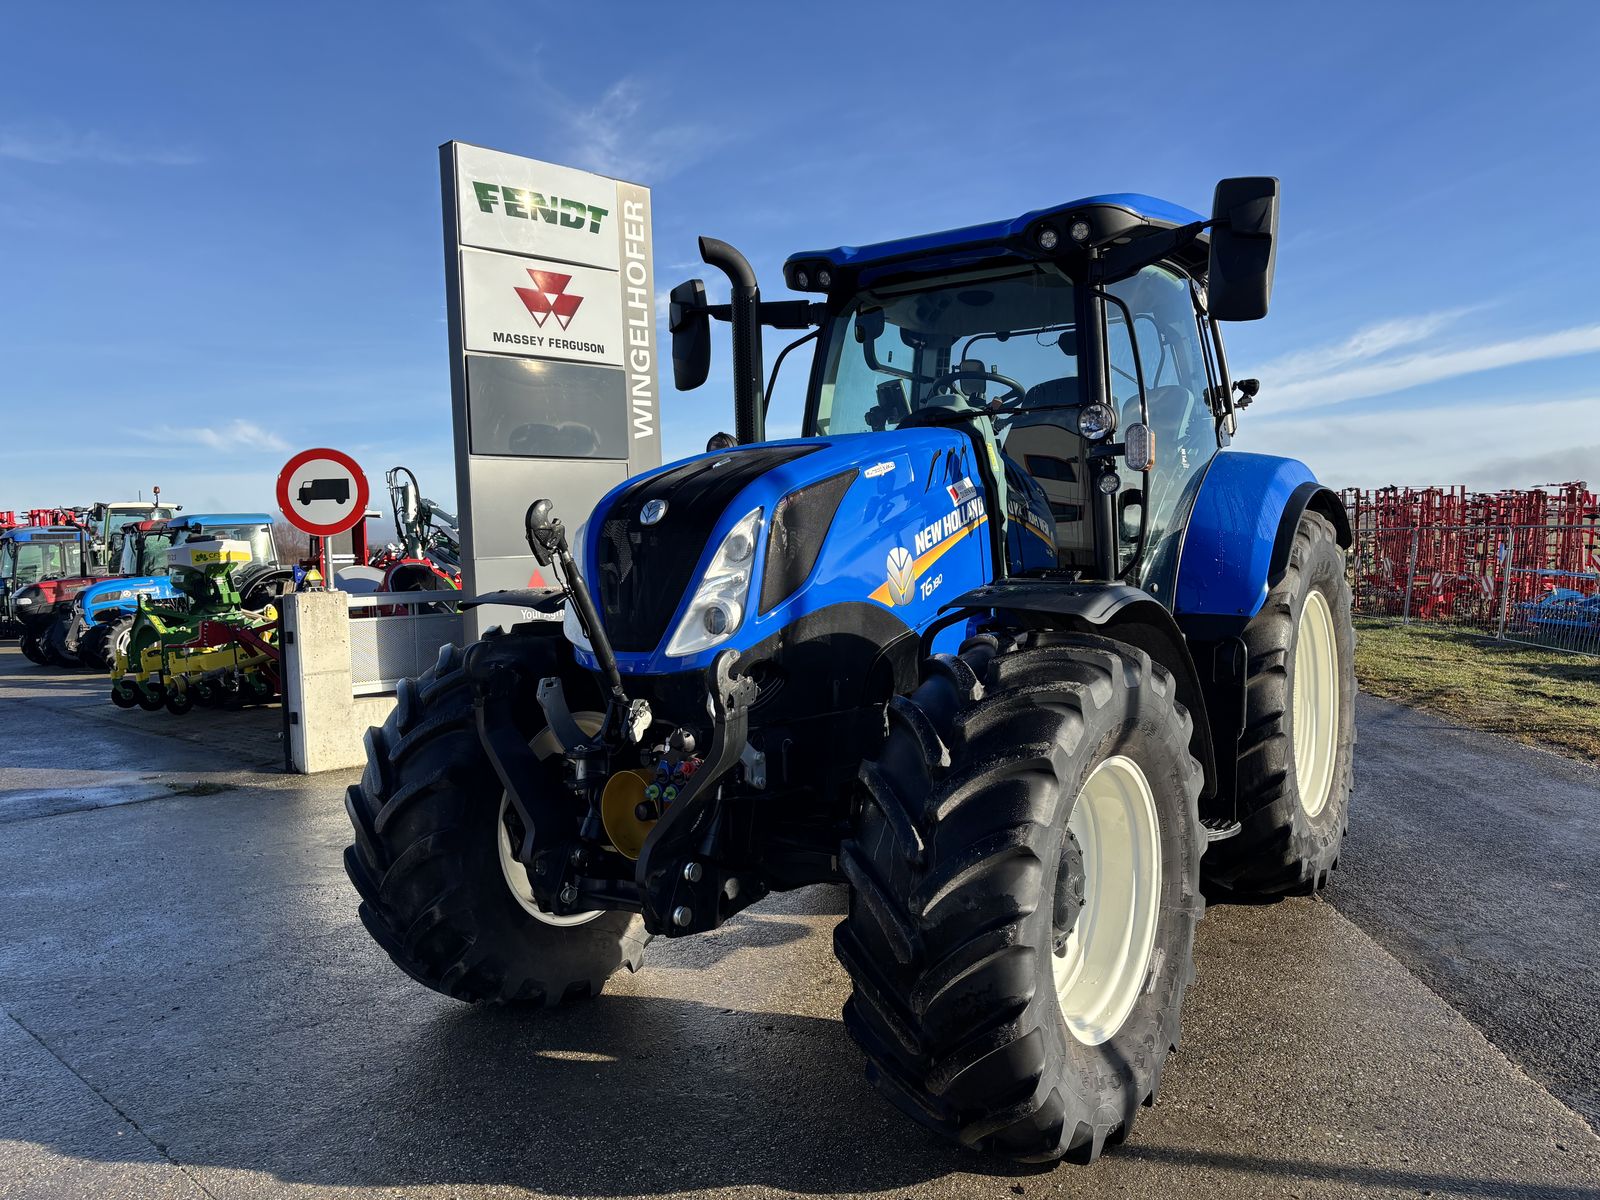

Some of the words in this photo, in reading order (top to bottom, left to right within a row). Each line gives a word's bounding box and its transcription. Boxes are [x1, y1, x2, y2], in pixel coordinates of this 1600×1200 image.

[471, 181, 609, 234] FENDT
[493, 331, 544, 347] MASSEY
[548, 338, 605, 354] FERGUSON
[623, 200, 654, 440] WINGELHOFER
[914, 519, 942, 556] NEW
[942, 495, 985, 537] HOLLAND
[520, 609, 541, 620] Your
